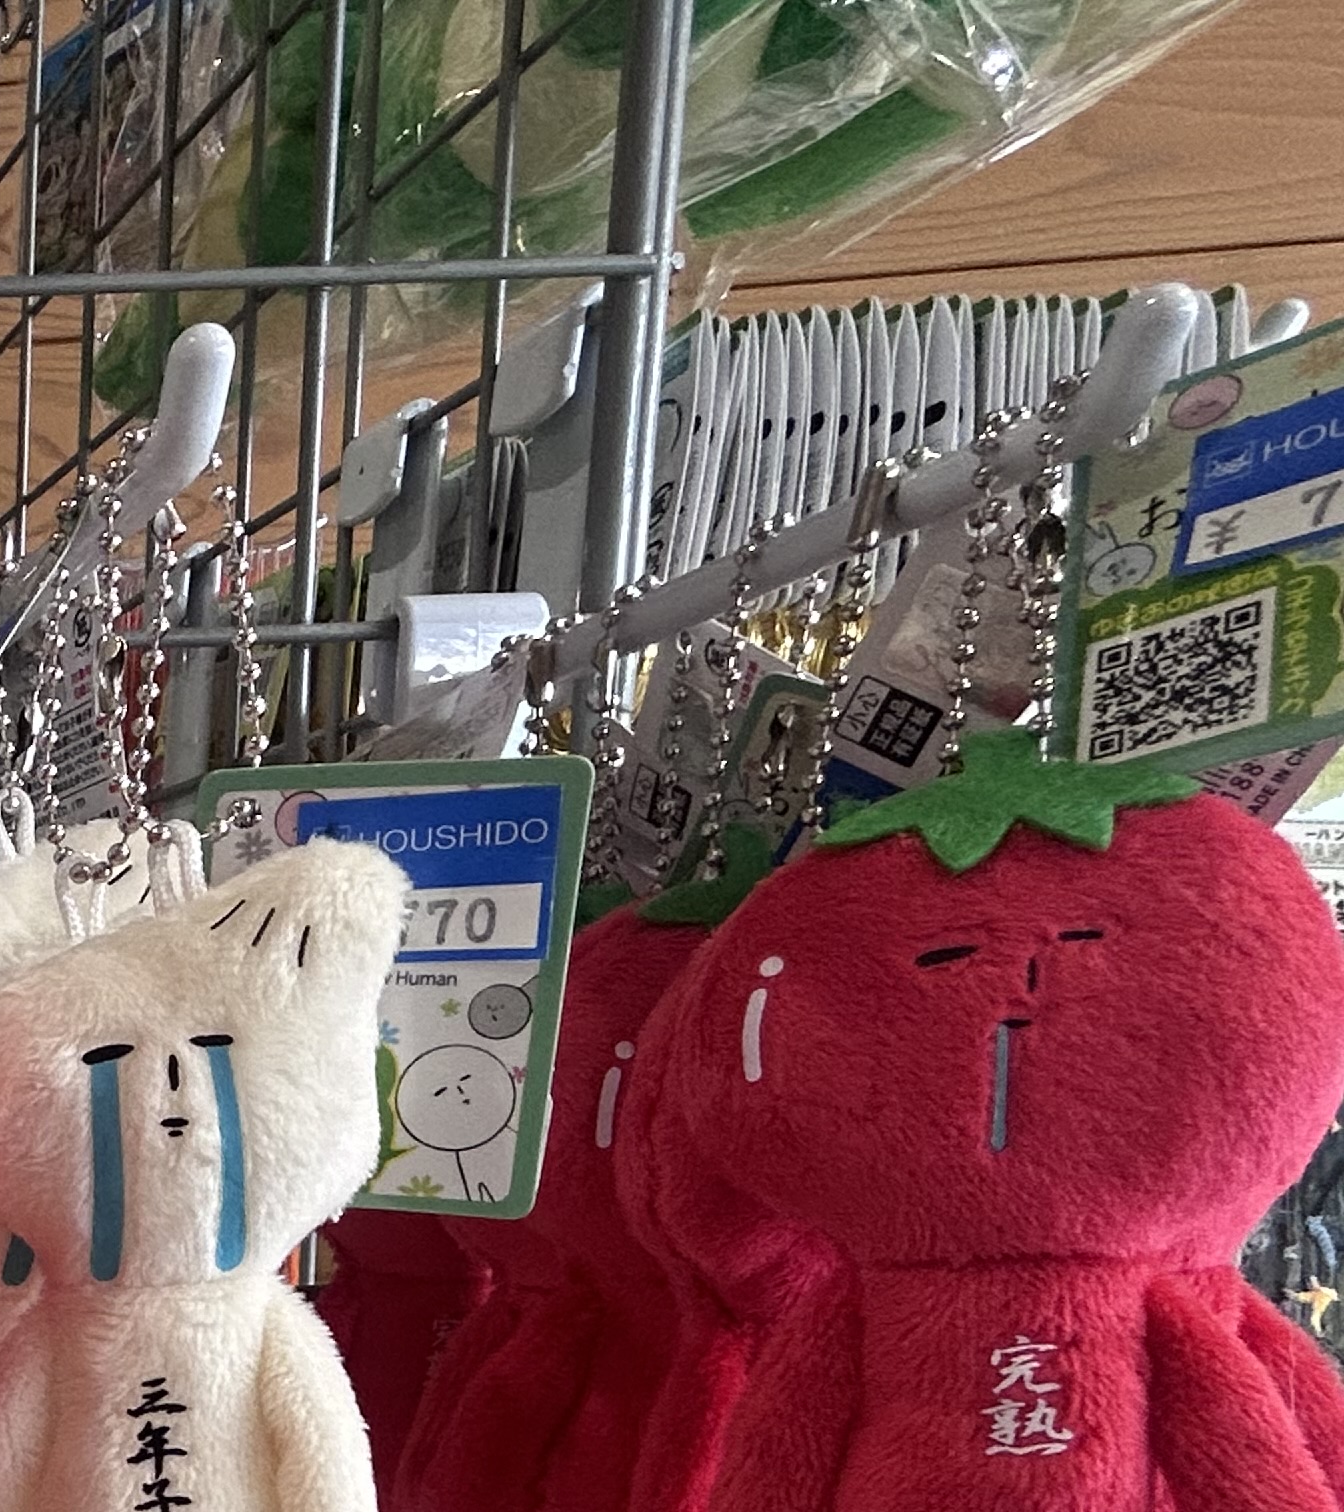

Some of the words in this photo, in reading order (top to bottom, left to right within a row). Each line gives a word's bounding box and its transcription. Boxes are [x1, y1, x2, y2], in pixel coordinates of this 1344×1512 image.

[1247, 784, 1279, 817] ADE
[395, 971, 458, 988] Human
[979, 1334, 1074, 1456] 完熟
